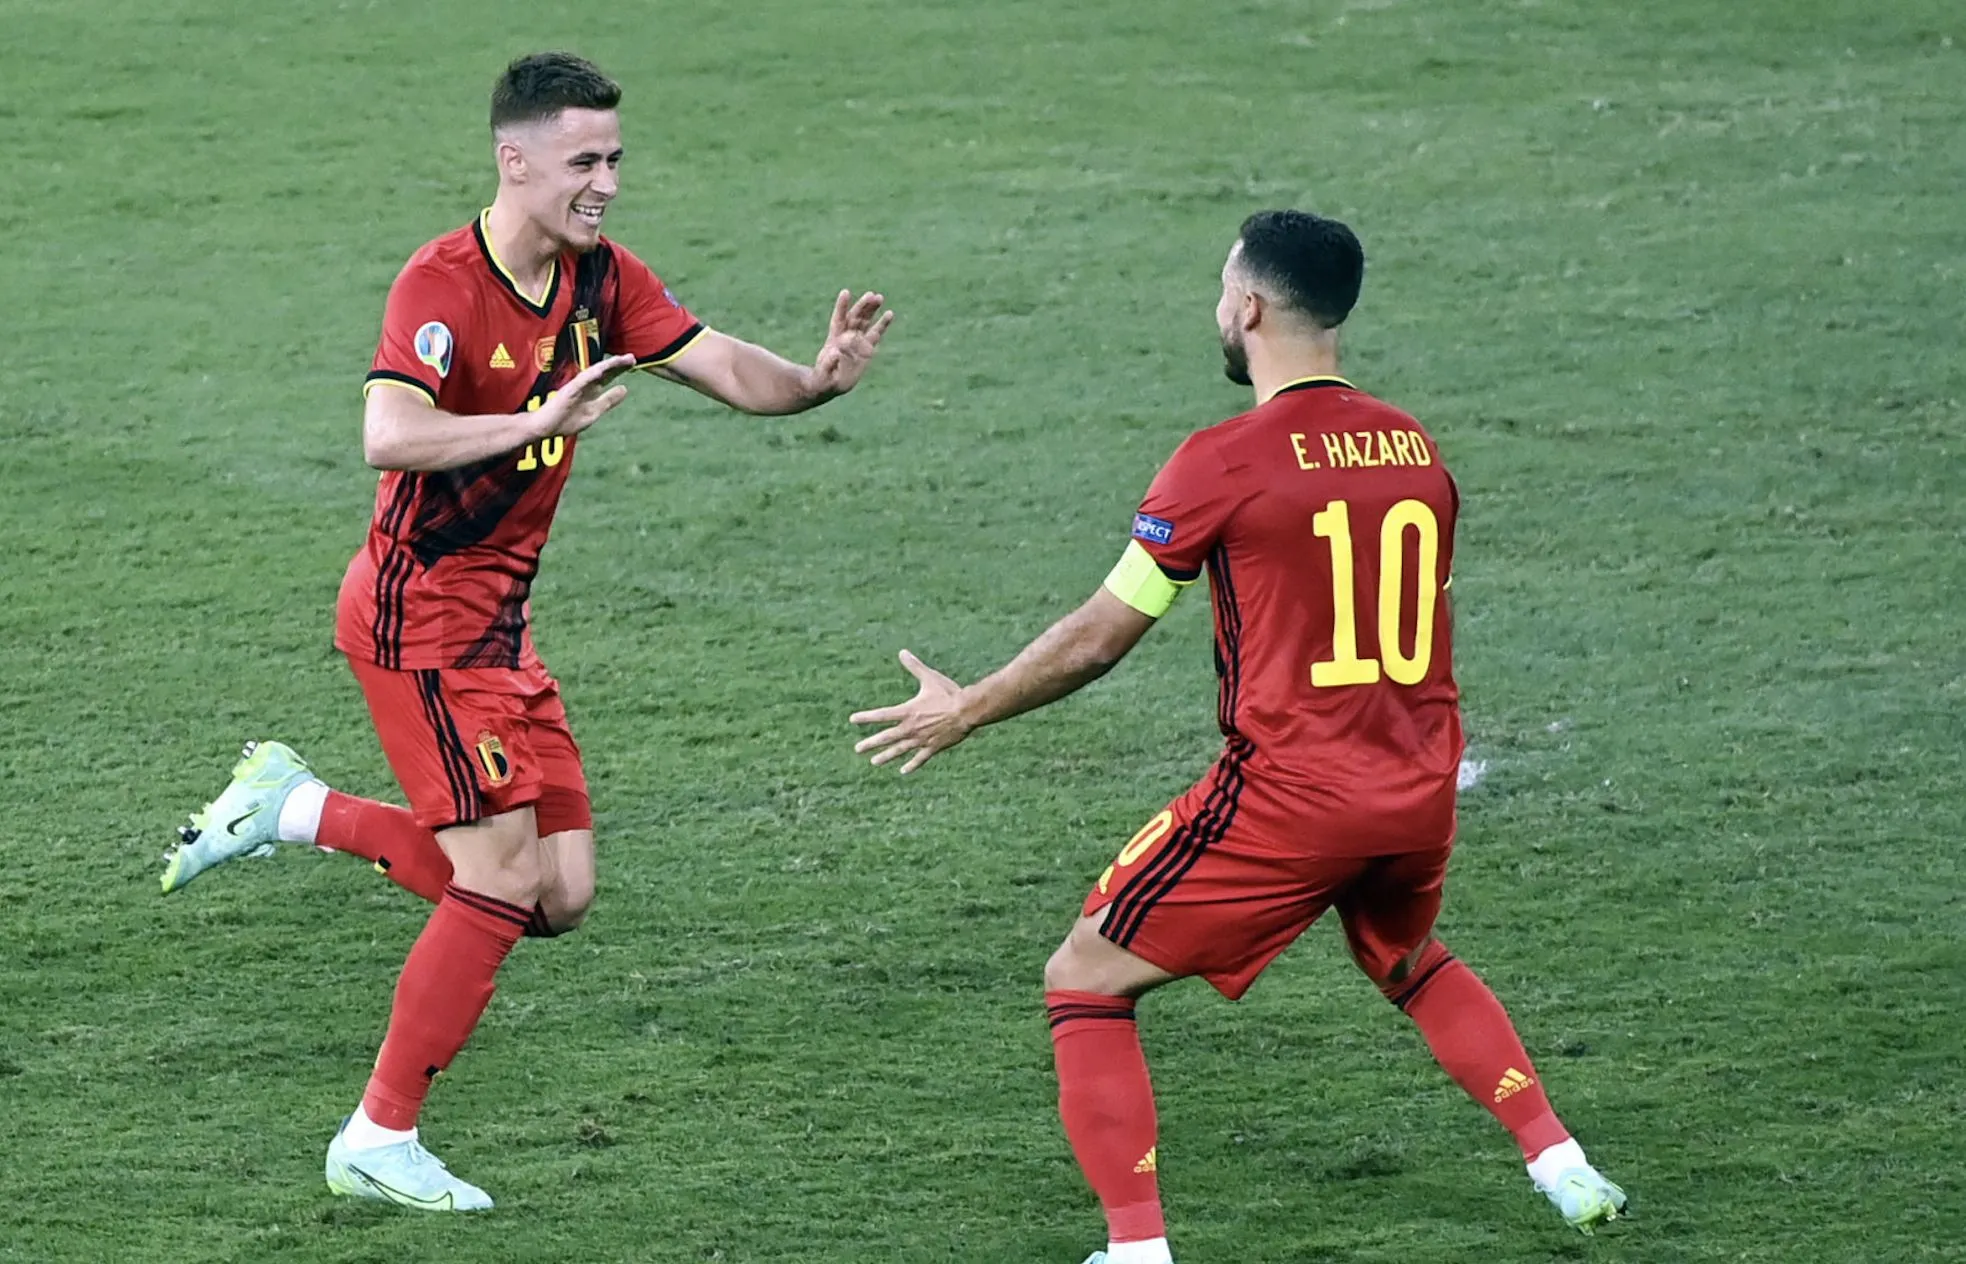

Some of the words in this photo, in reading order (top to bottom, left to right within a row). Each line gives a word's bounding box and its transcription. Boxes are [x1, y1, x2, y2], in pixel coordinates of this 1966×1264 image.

[1290, 432, 1320, 470] E.
[1321, 429, 1432, 468] HAZARD
[1311, 498, 1438, 687] 10
[1494, 1077, 1534, 1103] adidas
